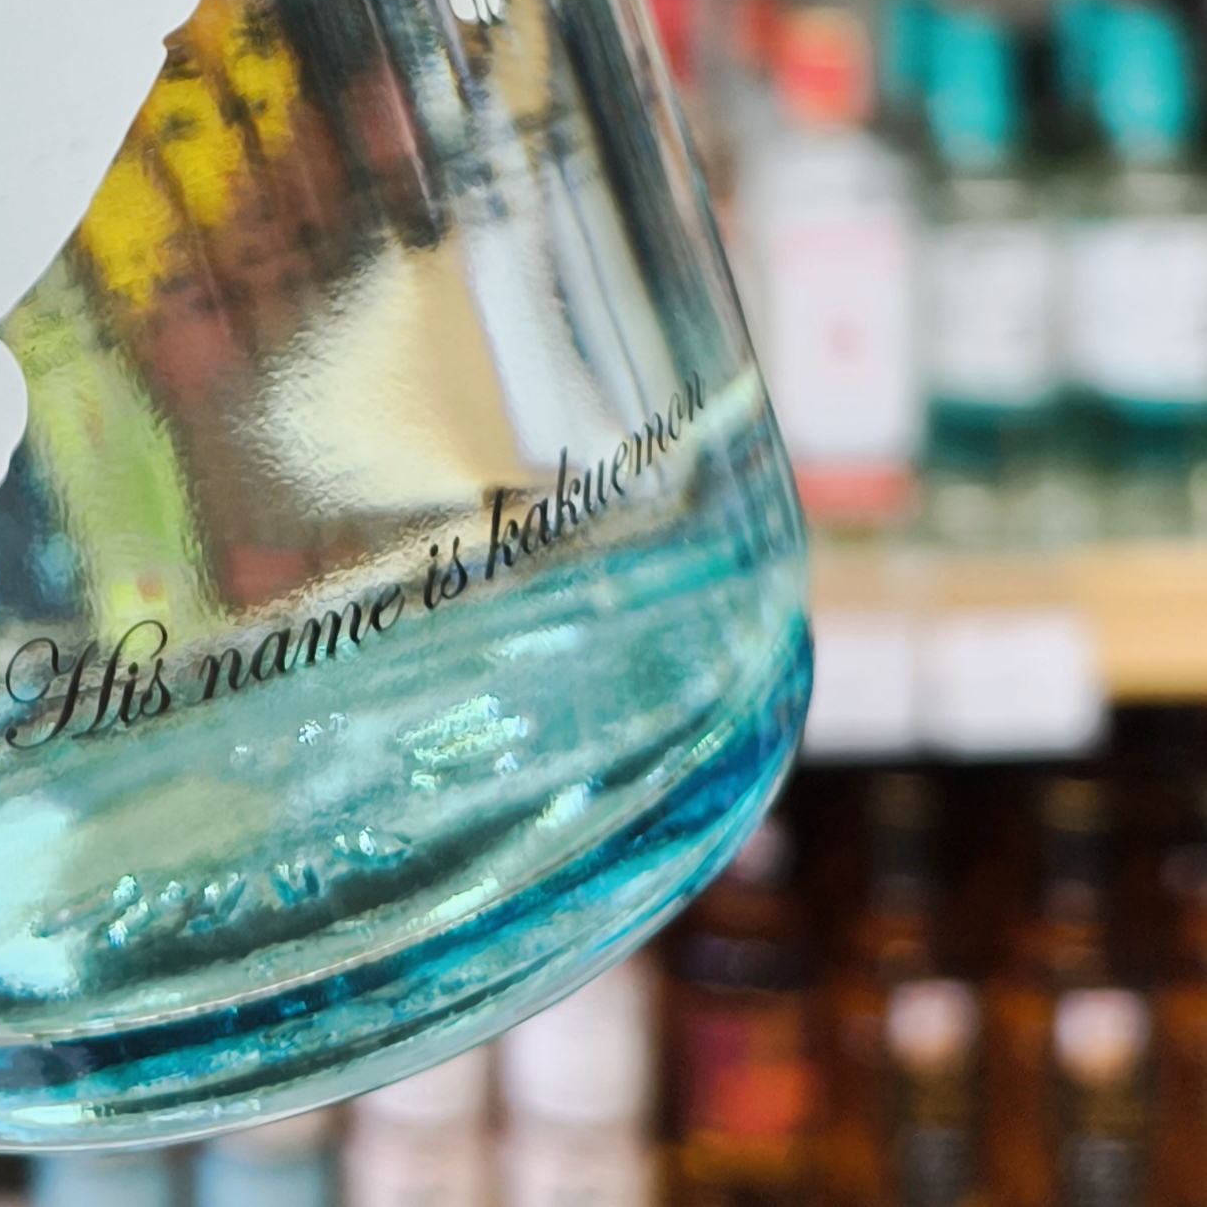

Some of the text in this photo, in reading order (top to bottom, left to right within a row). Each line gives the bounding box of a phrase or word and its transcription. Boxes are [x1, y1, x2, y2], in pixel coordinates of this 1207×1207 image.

[4, 369, 706, 751] His name is kakuemon
